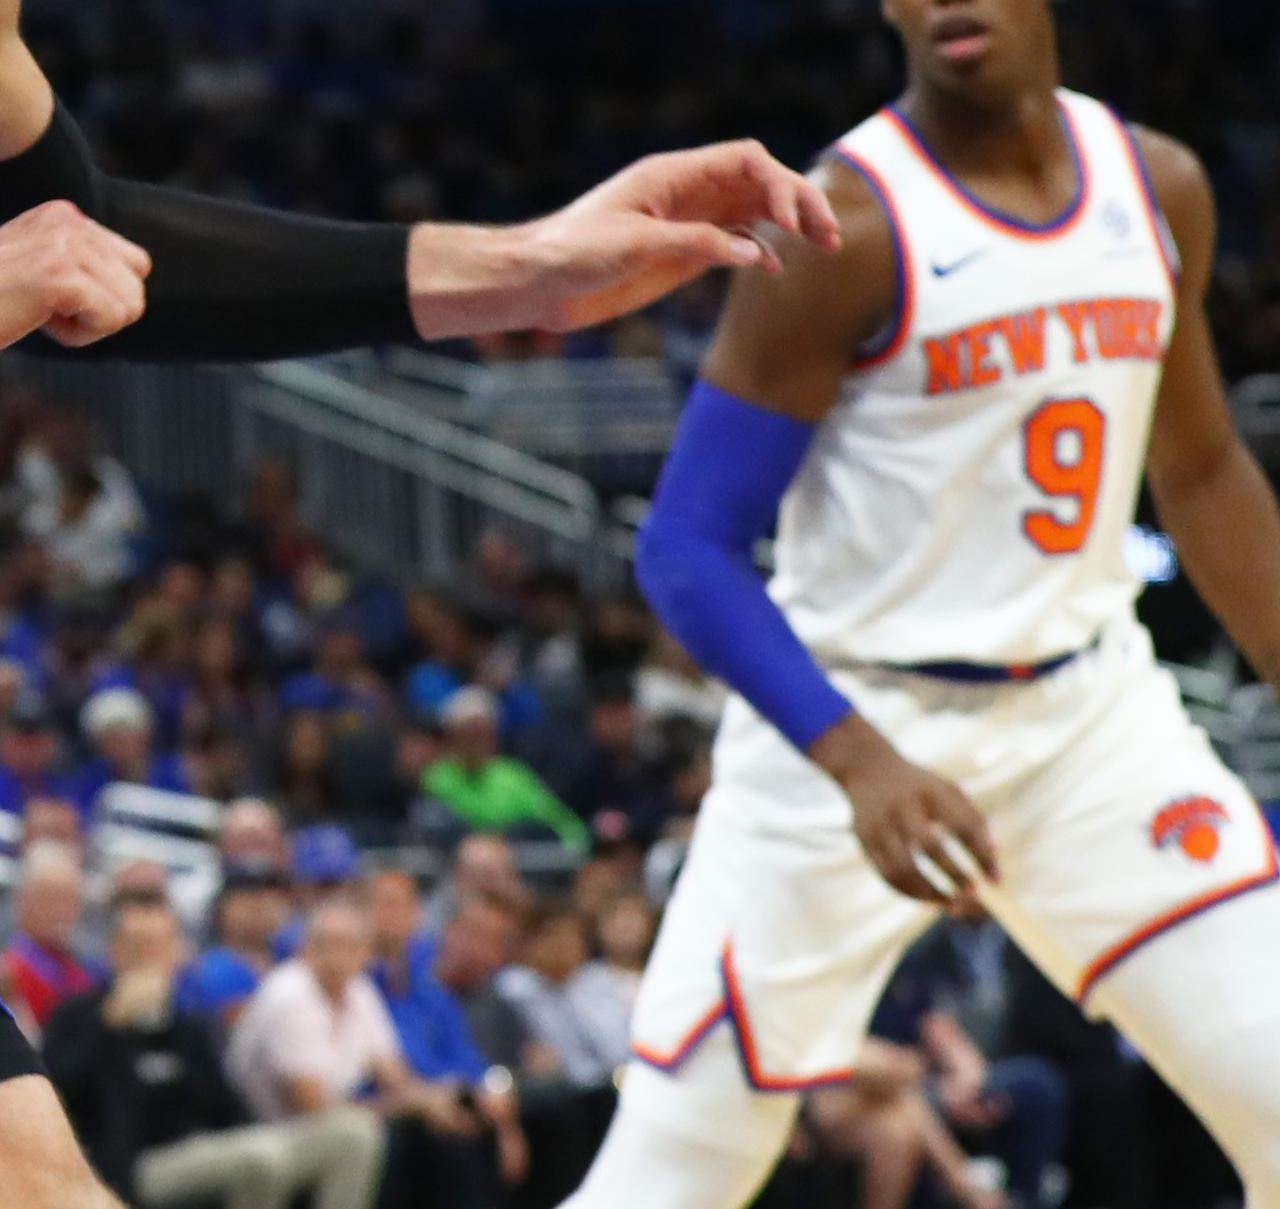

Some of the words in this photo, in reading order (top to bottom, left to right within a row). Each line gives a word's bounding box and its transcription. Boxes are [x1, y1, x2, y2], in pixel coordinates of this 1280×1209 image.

[922, 305, 1048, 396] NEW
[1055, 297, 1166, 364] YORK
[1023, 395, 1105, 555] 9
